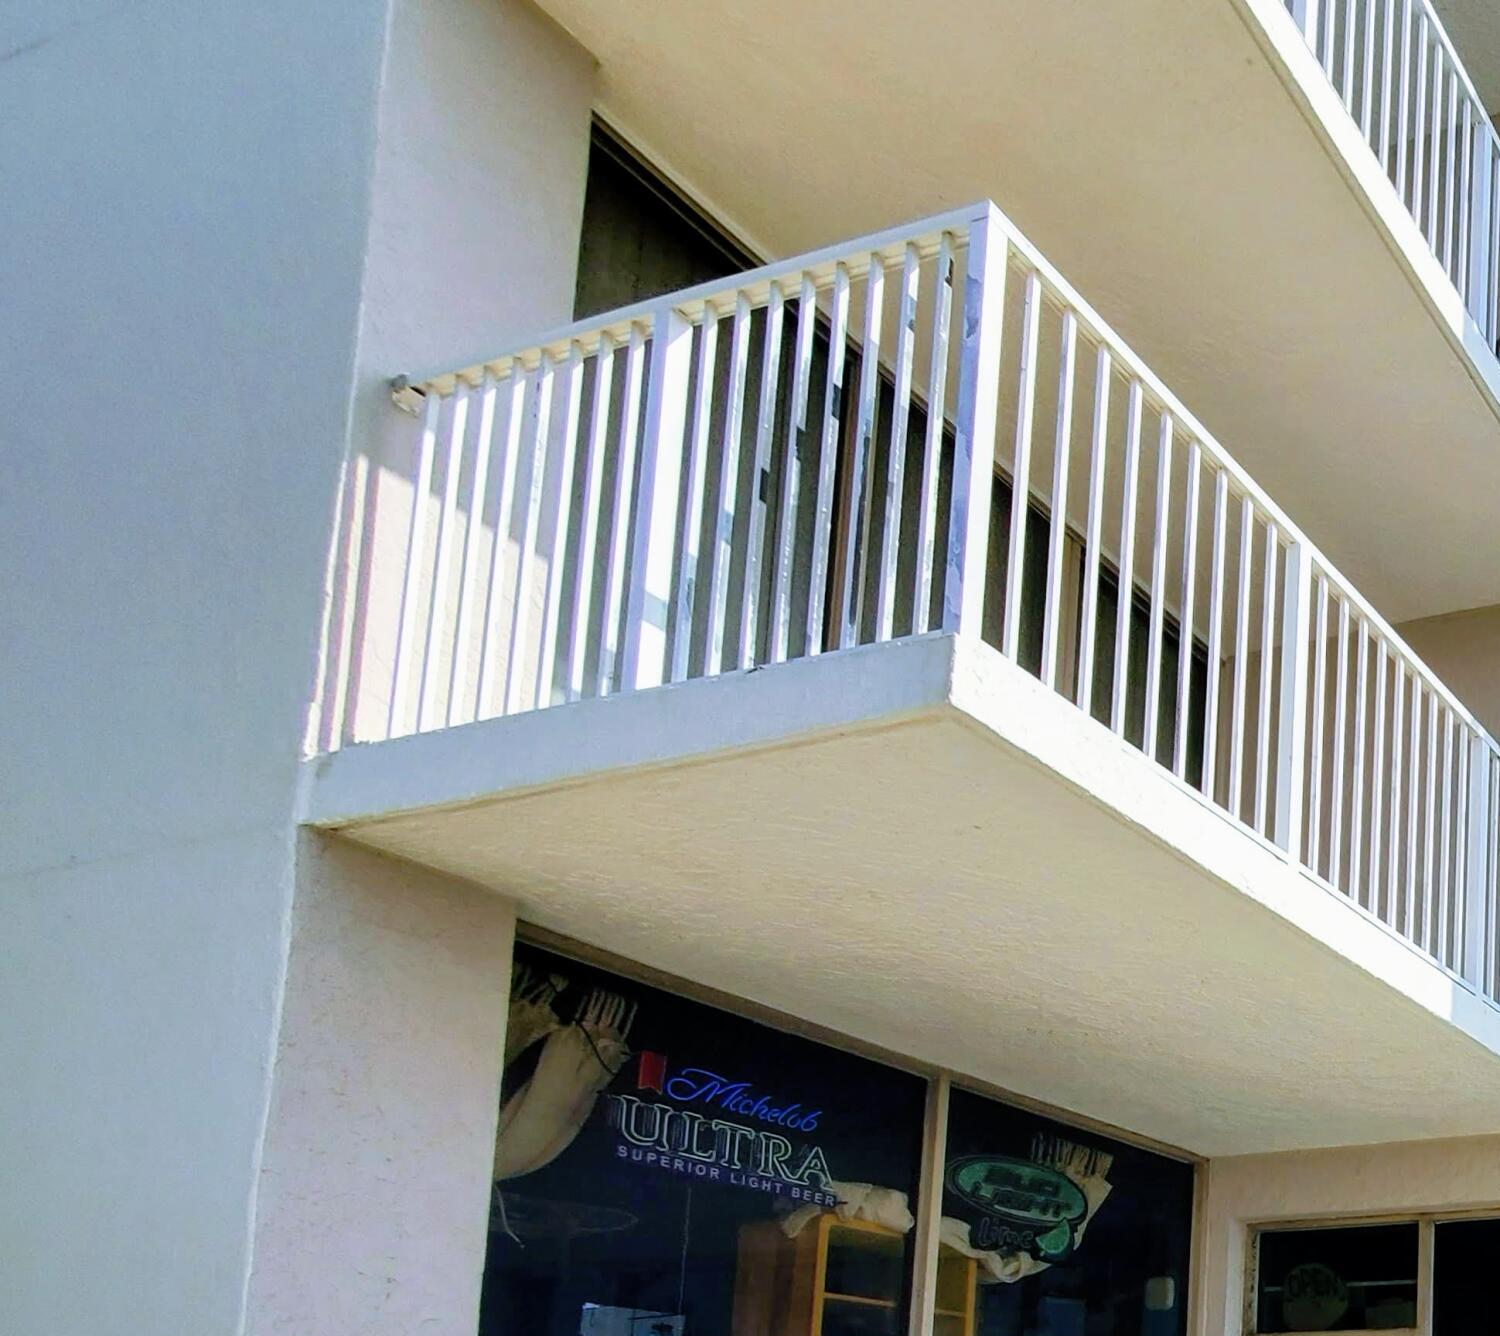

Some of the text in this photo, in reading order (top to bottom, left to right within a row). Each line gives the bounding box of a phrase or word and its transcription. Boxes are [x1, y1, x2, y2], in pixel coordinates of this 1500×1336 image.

[666, 1067, 823, 1133] Michelob
[617, 1093, 836, 1192] ULTRA
[616, 1145, 836, 1208] SUPERIOR LIGHT BEER
